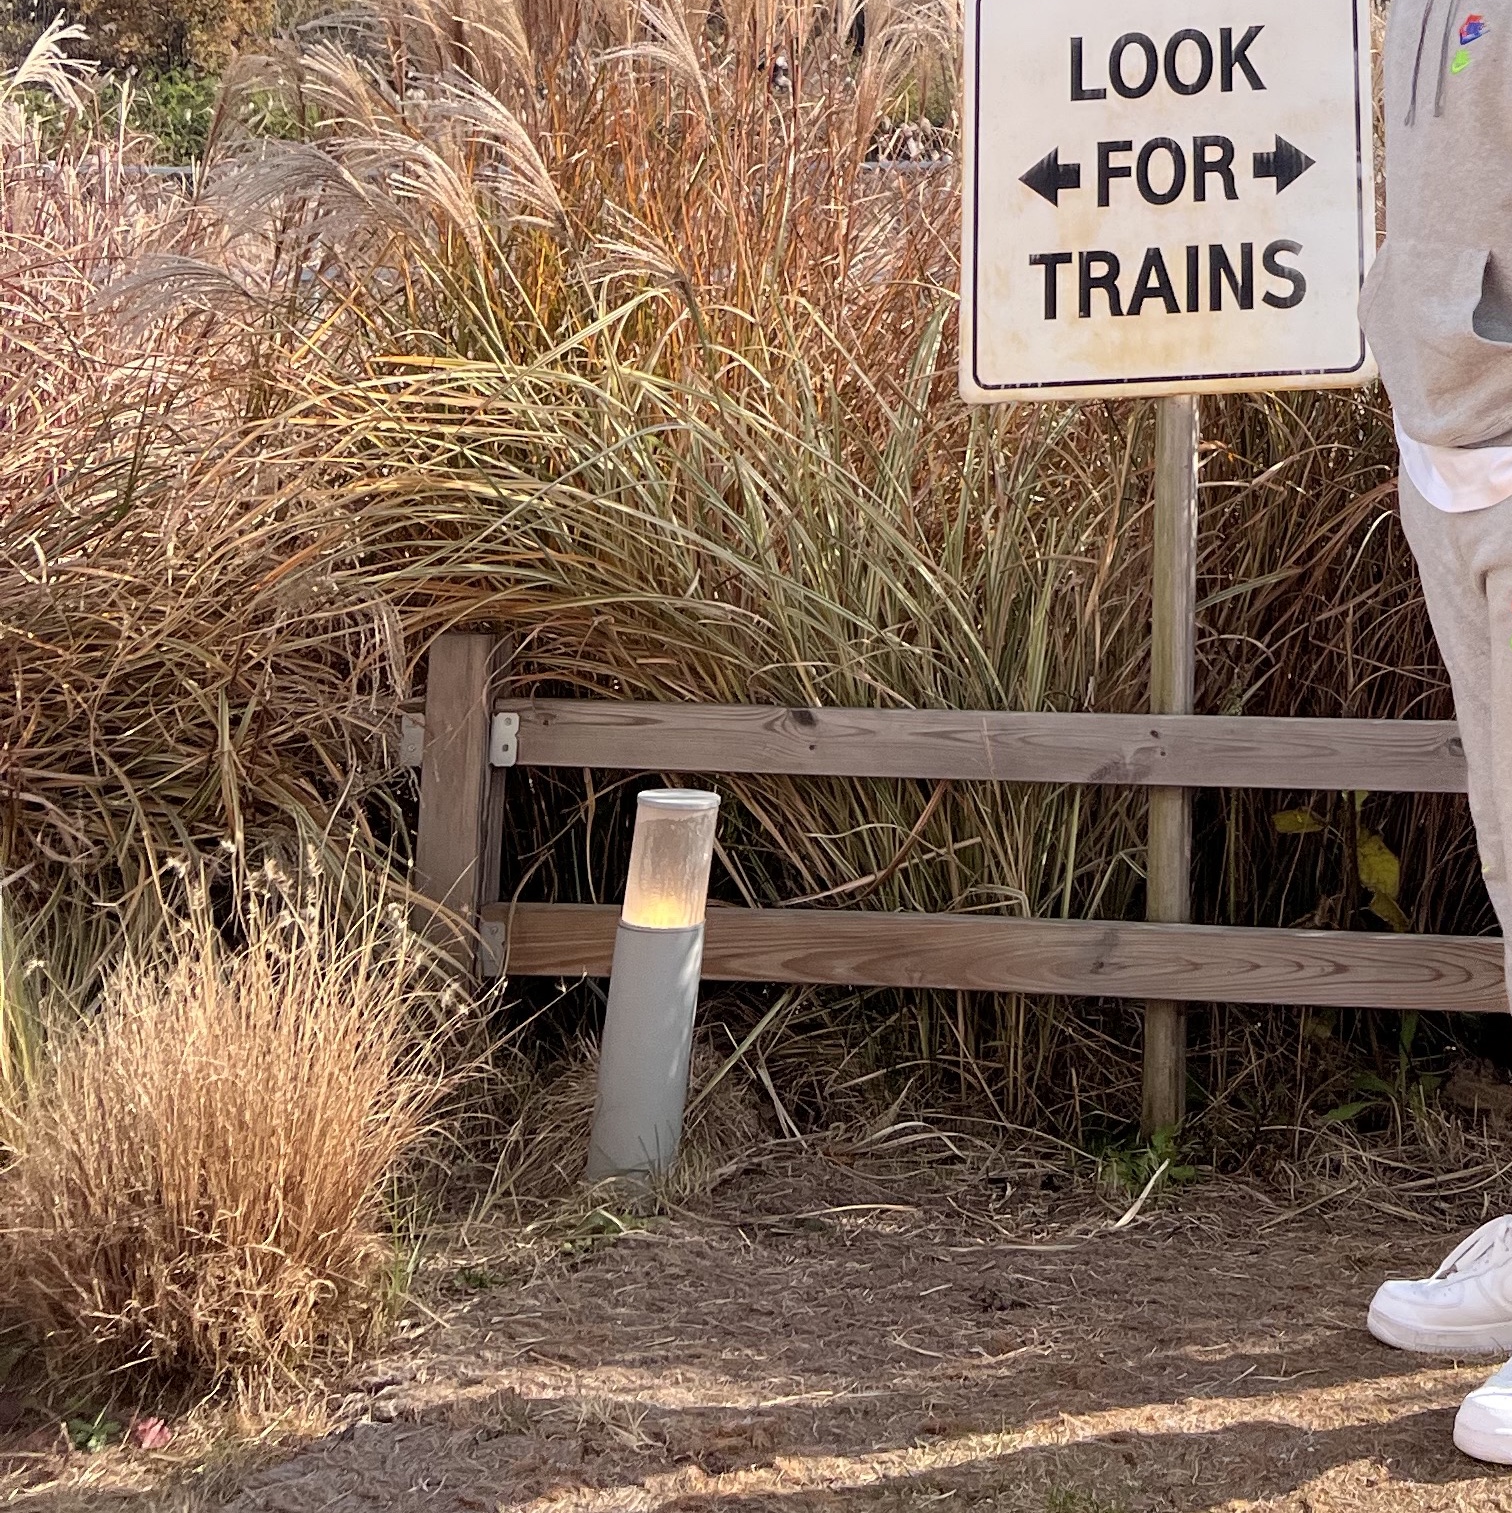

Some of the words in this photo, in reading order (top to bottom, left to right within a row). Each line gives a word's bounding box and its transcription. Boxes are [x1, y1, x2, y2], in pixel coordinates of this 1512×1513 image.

[1070, 24, 1267, 102] LOOK
[1097, 135, 1239, 208] FOR
[1028, 239, 1307, 320] TRAINS
